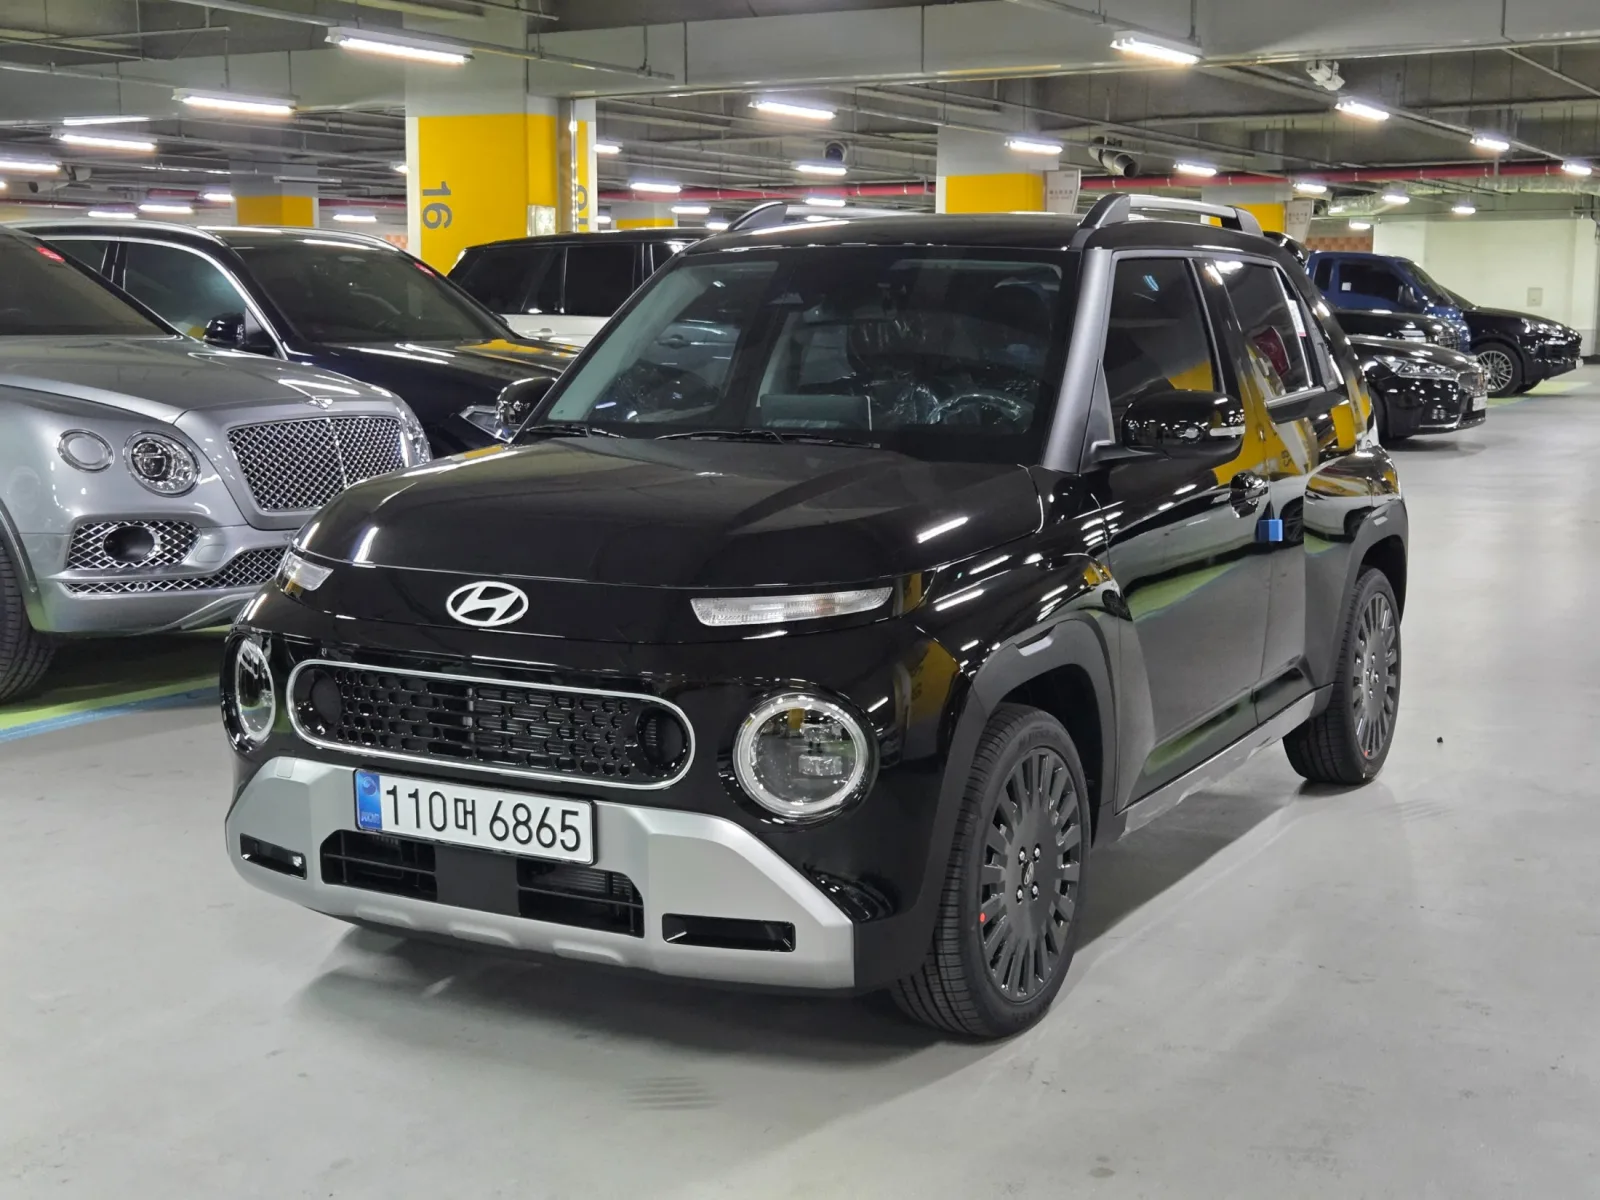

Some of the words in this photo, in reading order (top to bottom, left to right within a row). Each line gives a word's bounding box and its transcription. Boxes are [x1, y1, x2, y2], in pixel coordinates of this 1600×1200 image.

[422, 181, 453, 230] 16
[386, 784, 478, 836] 110머
[489, 799, 582, 852] 6865
